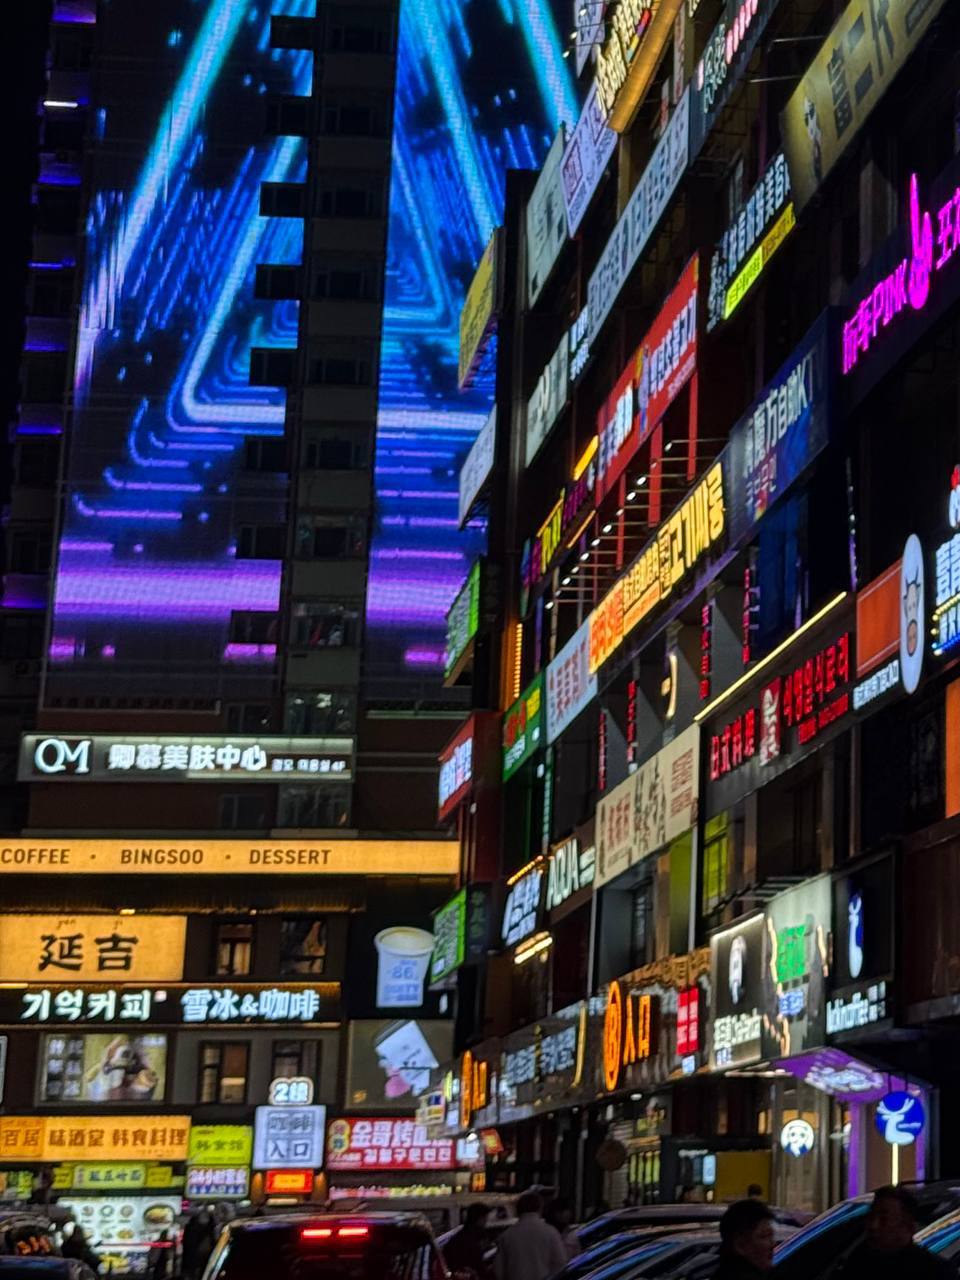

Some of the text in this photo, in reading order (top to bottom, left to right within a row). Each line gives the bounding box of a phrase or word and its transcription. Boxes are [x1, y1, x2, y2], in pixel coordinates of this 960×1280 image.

[1, 848, 332, 865] COFFEE BINGSOO DESSERT
[38, 931, 139, 973] 延吉
[22, 988, 152, 1022] 기억커피
[181, 988, 320, 1023] 雪冰&咖啡
[269, 1139, 310, 1161] 入口
